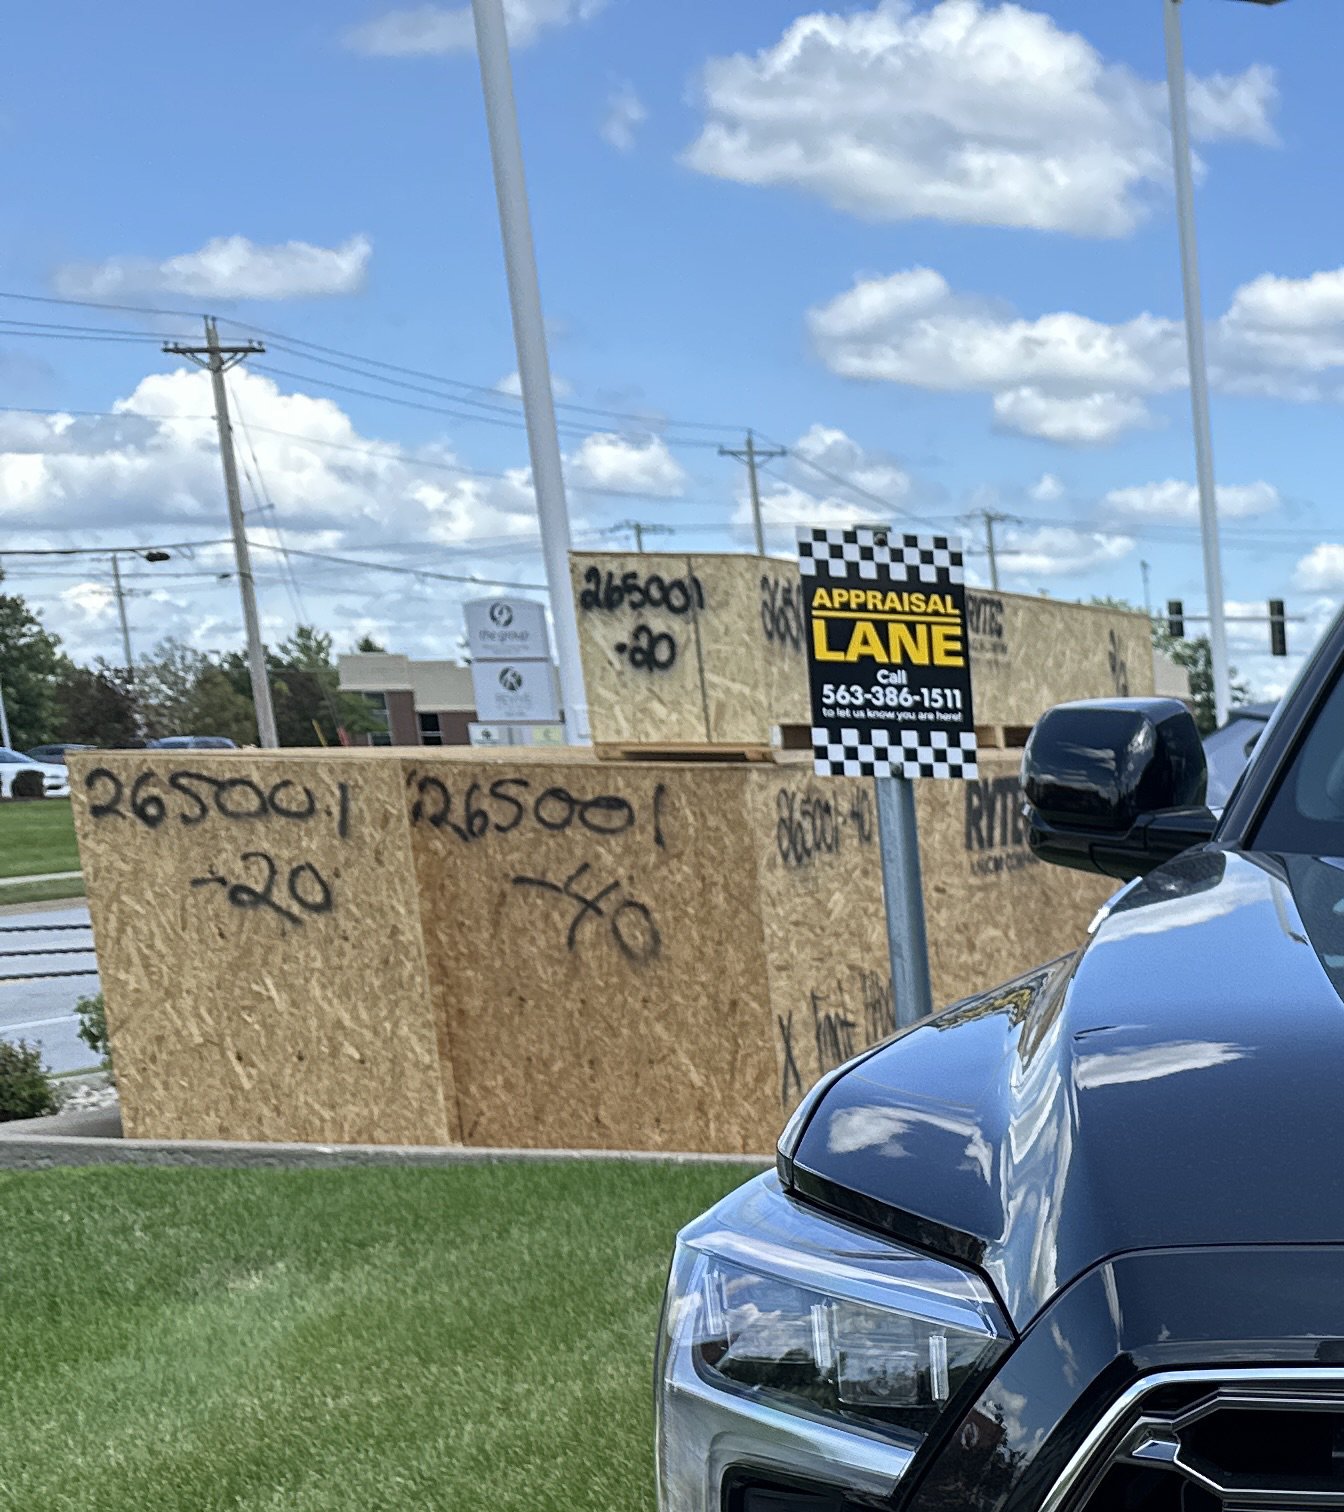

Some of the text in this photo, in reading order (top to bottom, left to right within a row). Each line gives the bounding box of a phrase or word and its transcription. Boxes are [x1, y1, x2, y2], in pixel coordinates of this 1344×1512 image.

[812, 587, 960, 616] APPRAISAL
[812, 618, 965, 667] LANE
[821, 684, 962, 710] 563-386-1511
[876, 668, 908, 686] Call
[821, 706, 836, 719] to
[836, 706, 852, 719] let
[852, 708, 866, 719] us
[866, 707, 896, 721] know
[896, 710, 917, 723] you
[918, 711, 935, 721] are
[84, 768, 350, 839] 265001
[405, 770, 667, 849] 265001
[965, 776, 1030, 851] RYTE
[190, 851, 334, 926] -20
